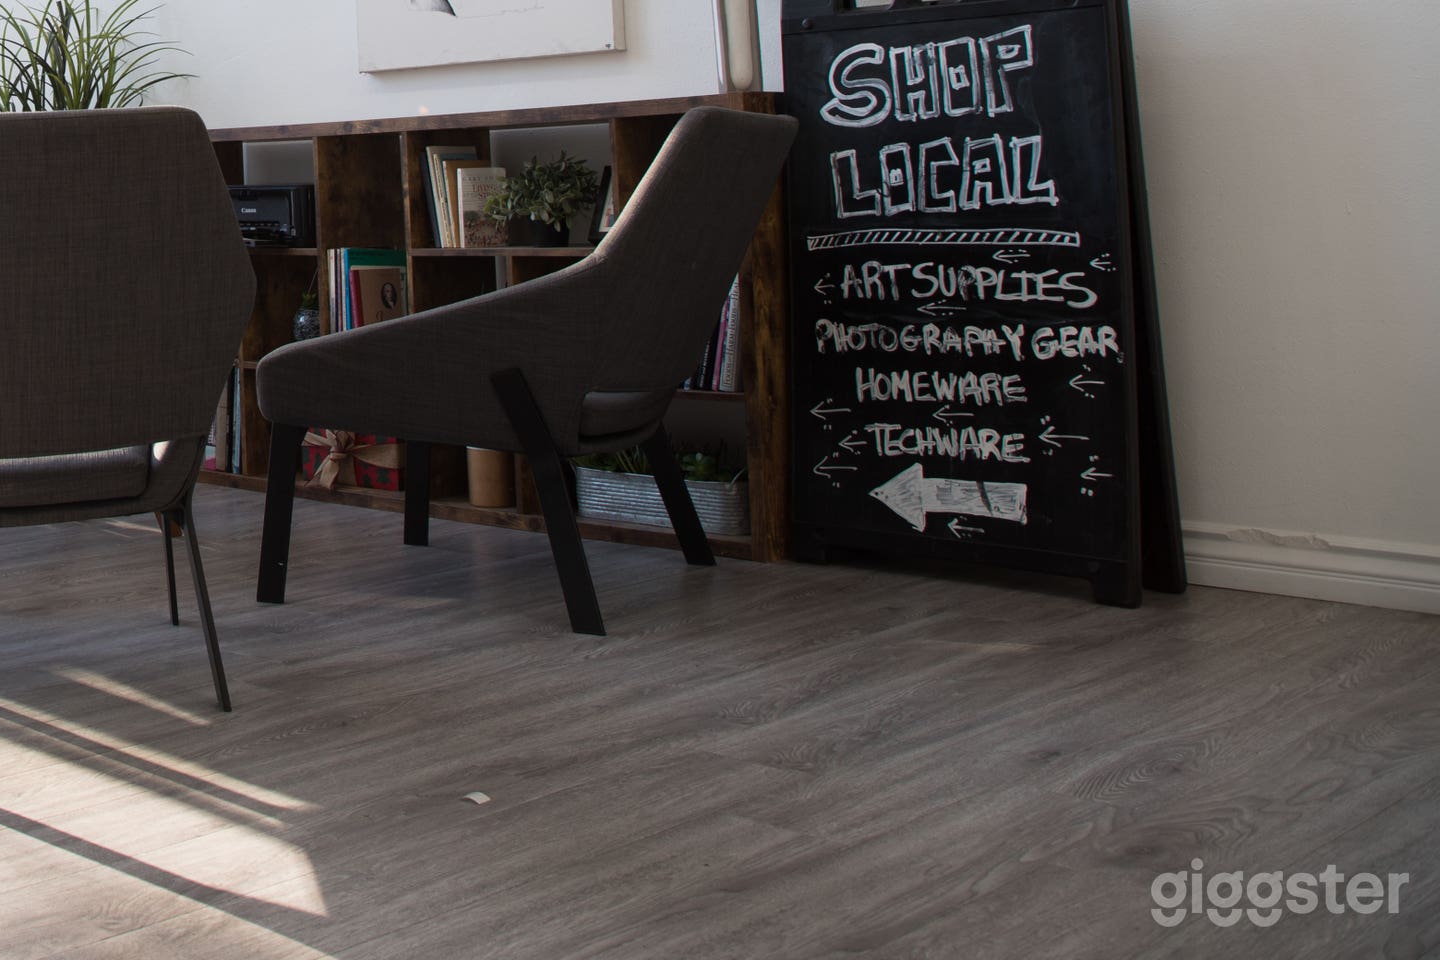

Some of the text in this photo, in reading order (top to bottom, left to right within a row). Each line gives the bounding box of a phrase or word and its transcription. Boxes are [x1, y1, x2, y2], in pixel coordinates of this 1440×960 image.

[820, 24, 1034, 127] SHOP
[830, 133, 1059, 219] LOCAL
[840, 260, 1098, 309] ART SUPPLIES
[816, 318, 1119, 361] PHOTOGRAPHY GEAR
[856, 367, 1027, 406] HOMEWARE
[865, 423, 1031, 463] TECHWARE
